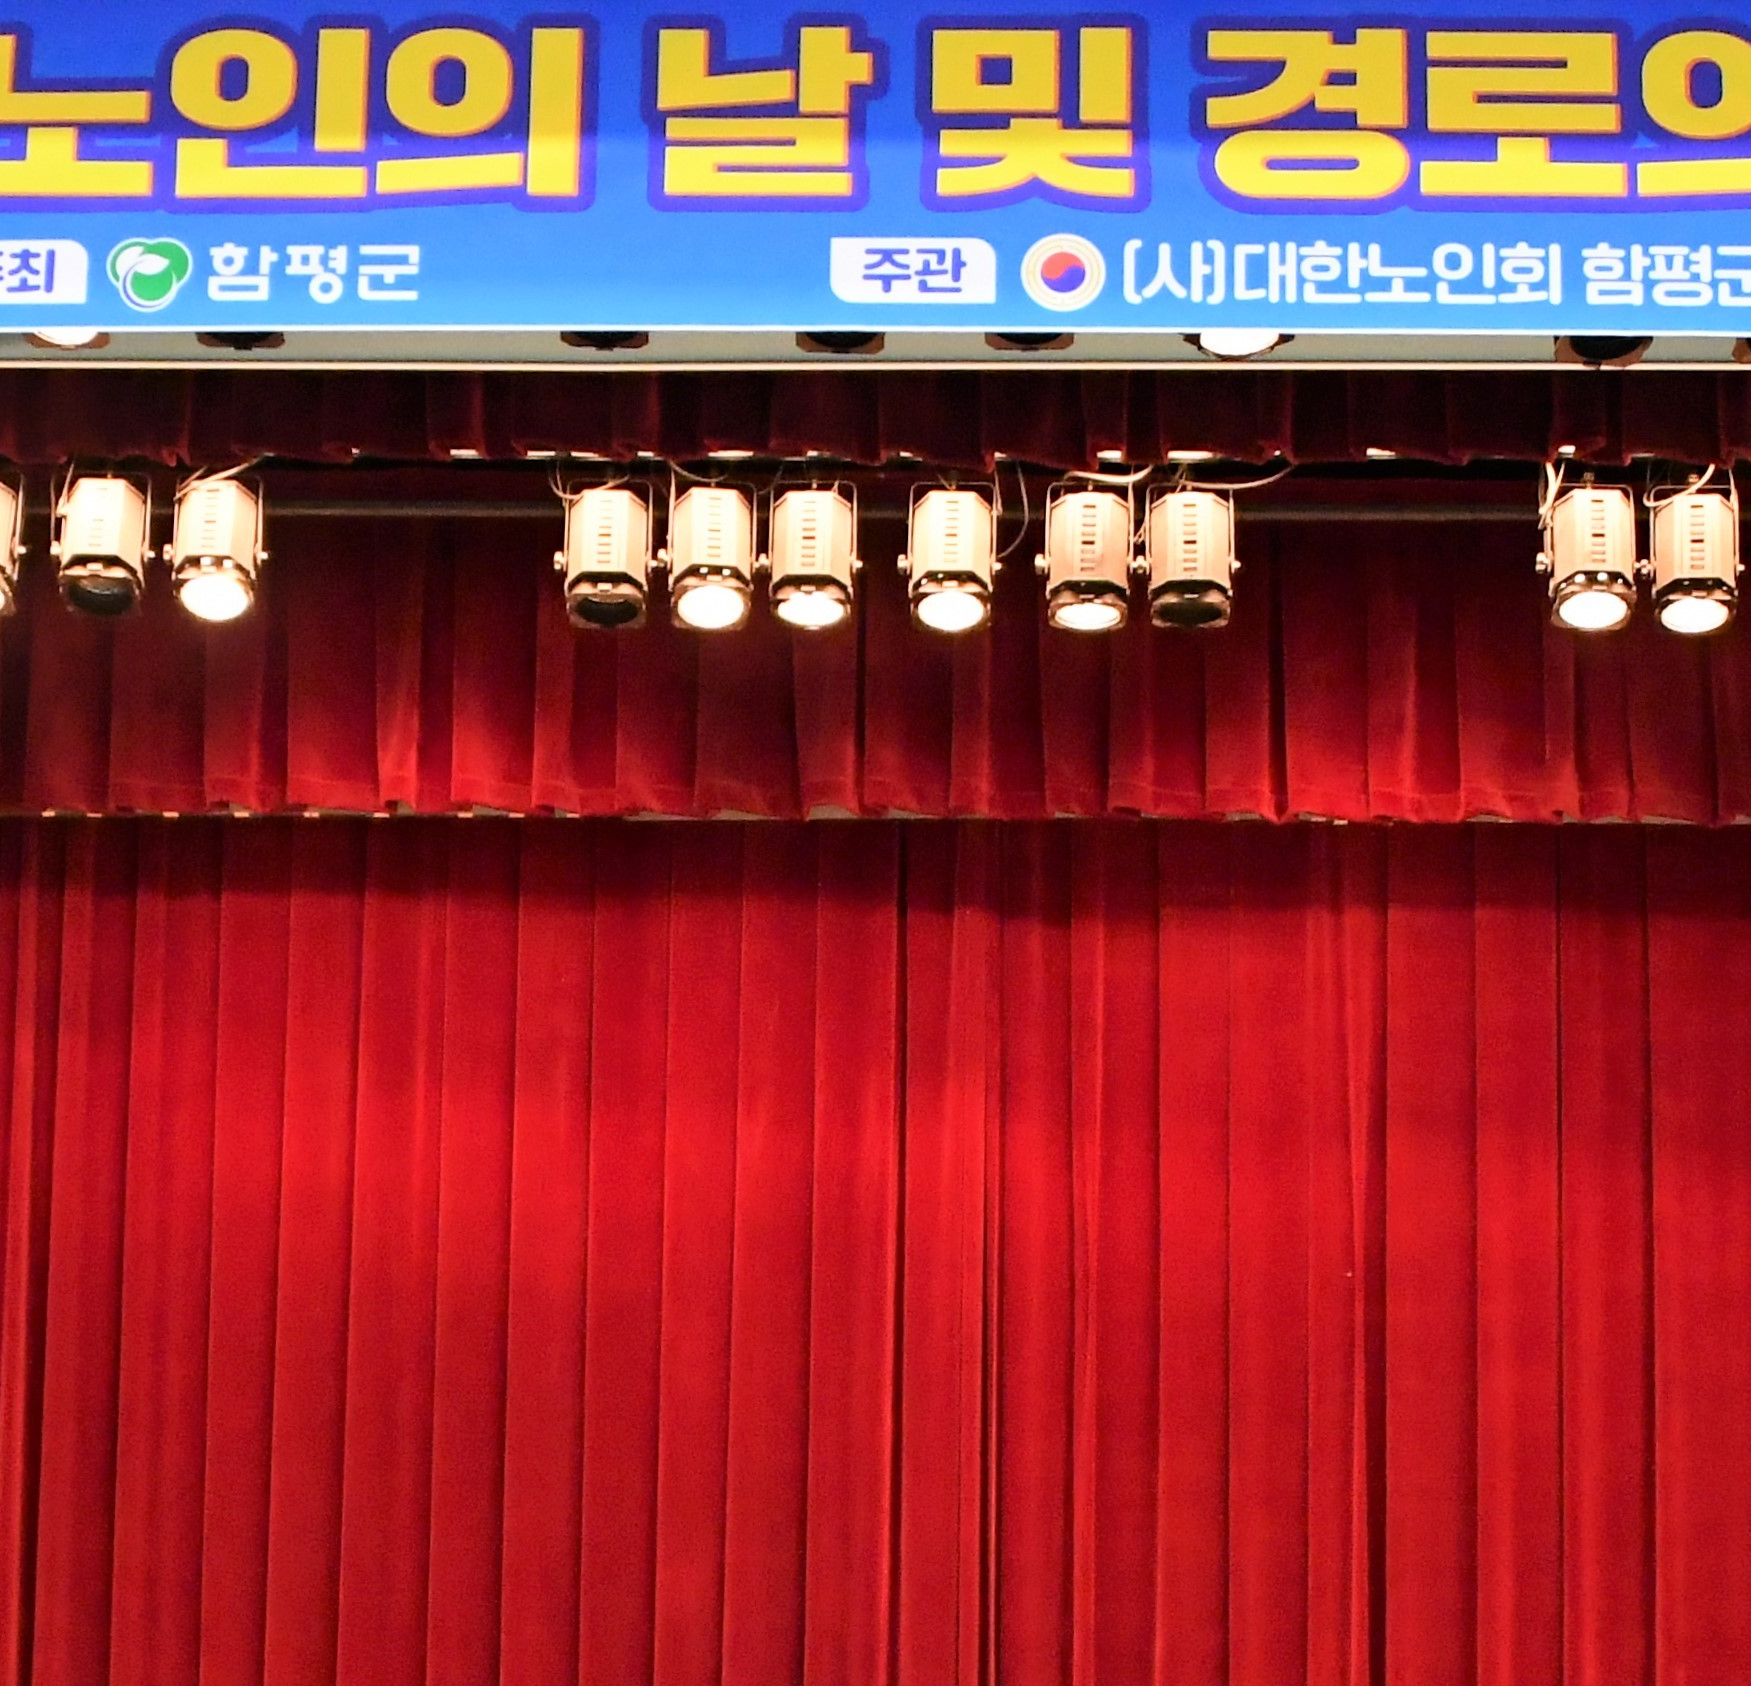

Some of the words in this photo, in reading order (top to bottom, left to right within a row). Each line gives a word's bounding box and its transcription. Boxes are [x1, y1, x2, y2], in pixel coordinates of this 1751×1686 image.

[656, 26, 874, 198] 날
[930, 26, 1136, 199] 및
[206, 242, 420, 302] 함평군
[860, 247, 967, 294] 주관
